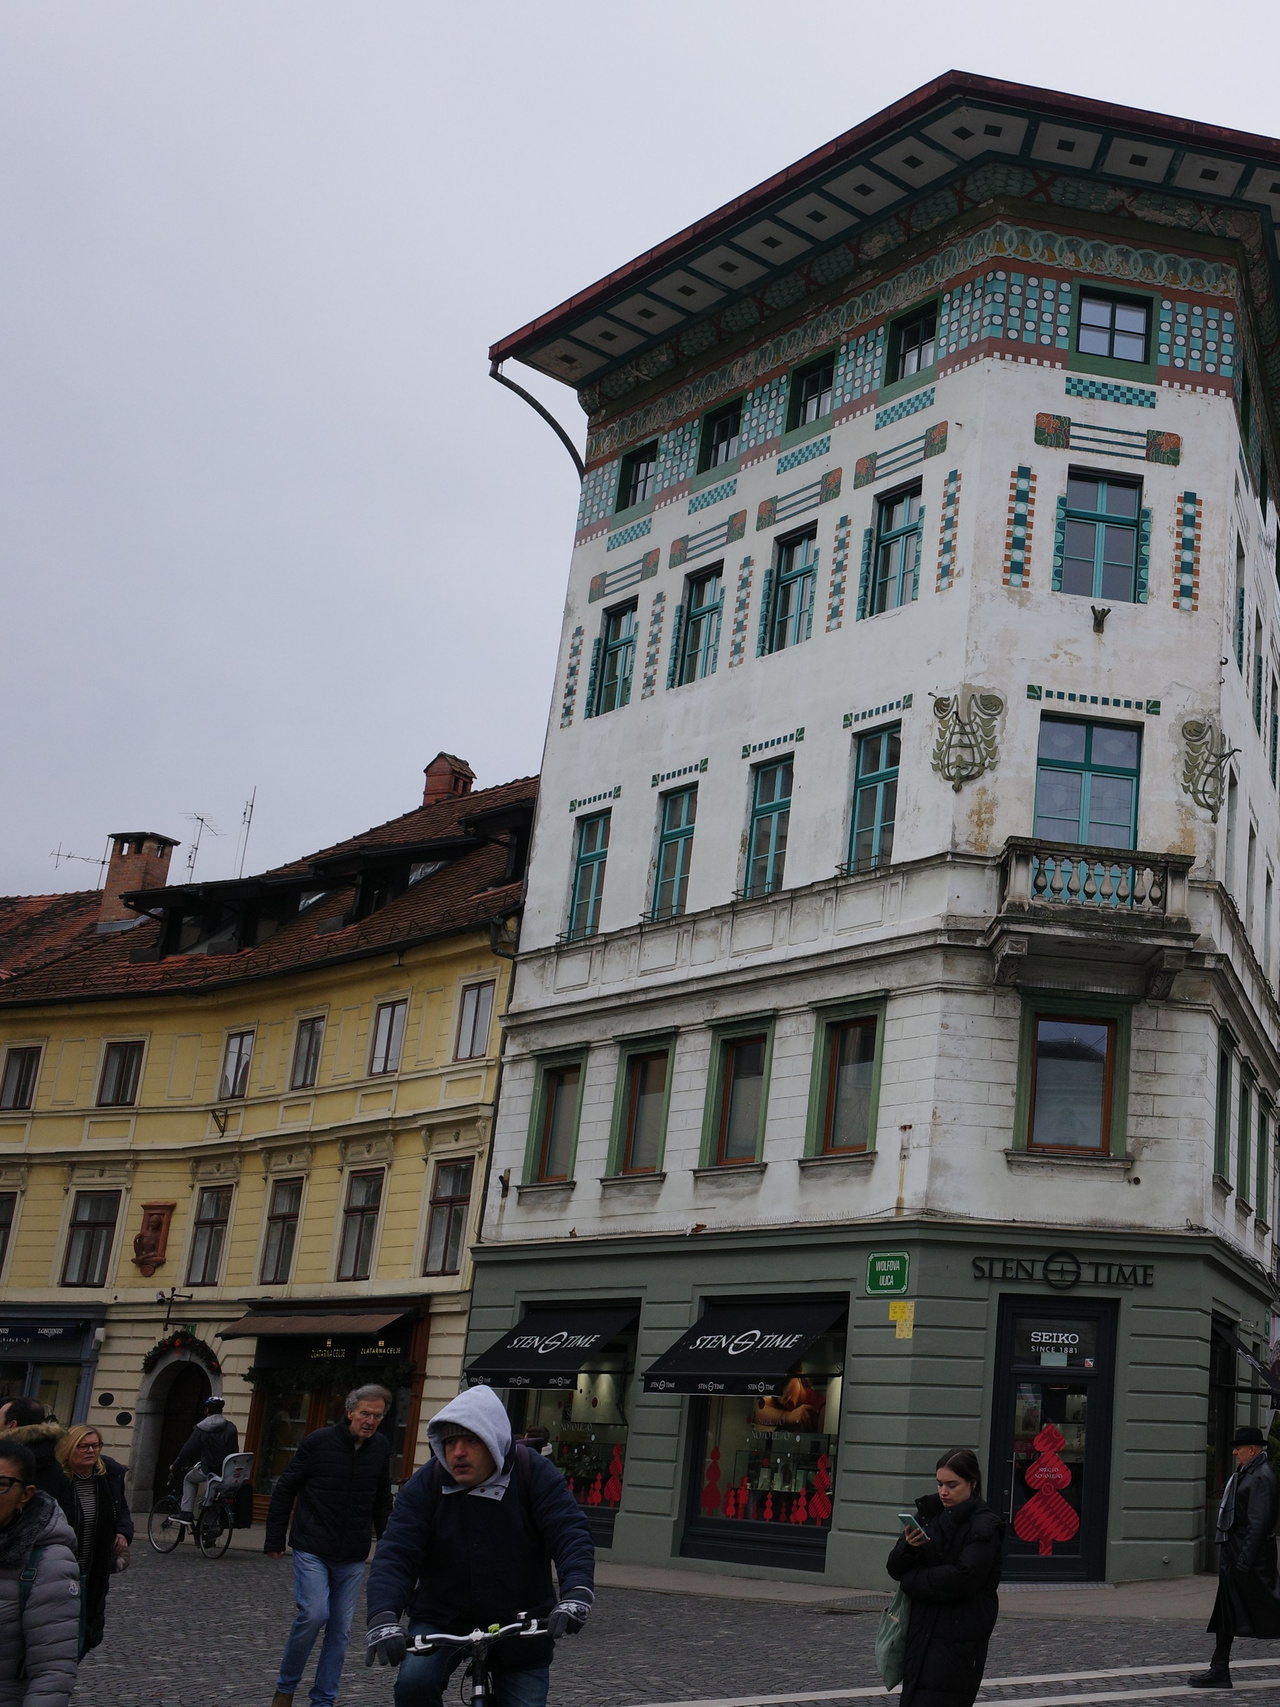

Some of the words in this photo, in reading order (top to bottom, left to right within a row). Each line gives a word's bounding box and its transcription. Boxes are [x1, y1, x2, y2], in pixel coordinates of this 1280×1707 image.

[875, 1260, 901, 1272] WOLFOVA
[972, 1256, 1037, 1281] STEN
[1088, 1261, 1154, 1286] TIME
[879, 1274, 894, 1286] ULICA
[506, 1335, 547, 1349] STEN
[561, 1334, 601, 1348] TIME
[689, 1334, 734, 1350] STEN
[756, 1333, 804, 1350] TIME
[1030, 1331, 1080, 1345] SEIKO
[360, 1347, 386, 1355] ZLATARNA
[387, 1347, 402, 1355] CELJE
[1030, 1345, 1056, 1353] SINCE
[1059, 1346, 1078, 1354] 1881
